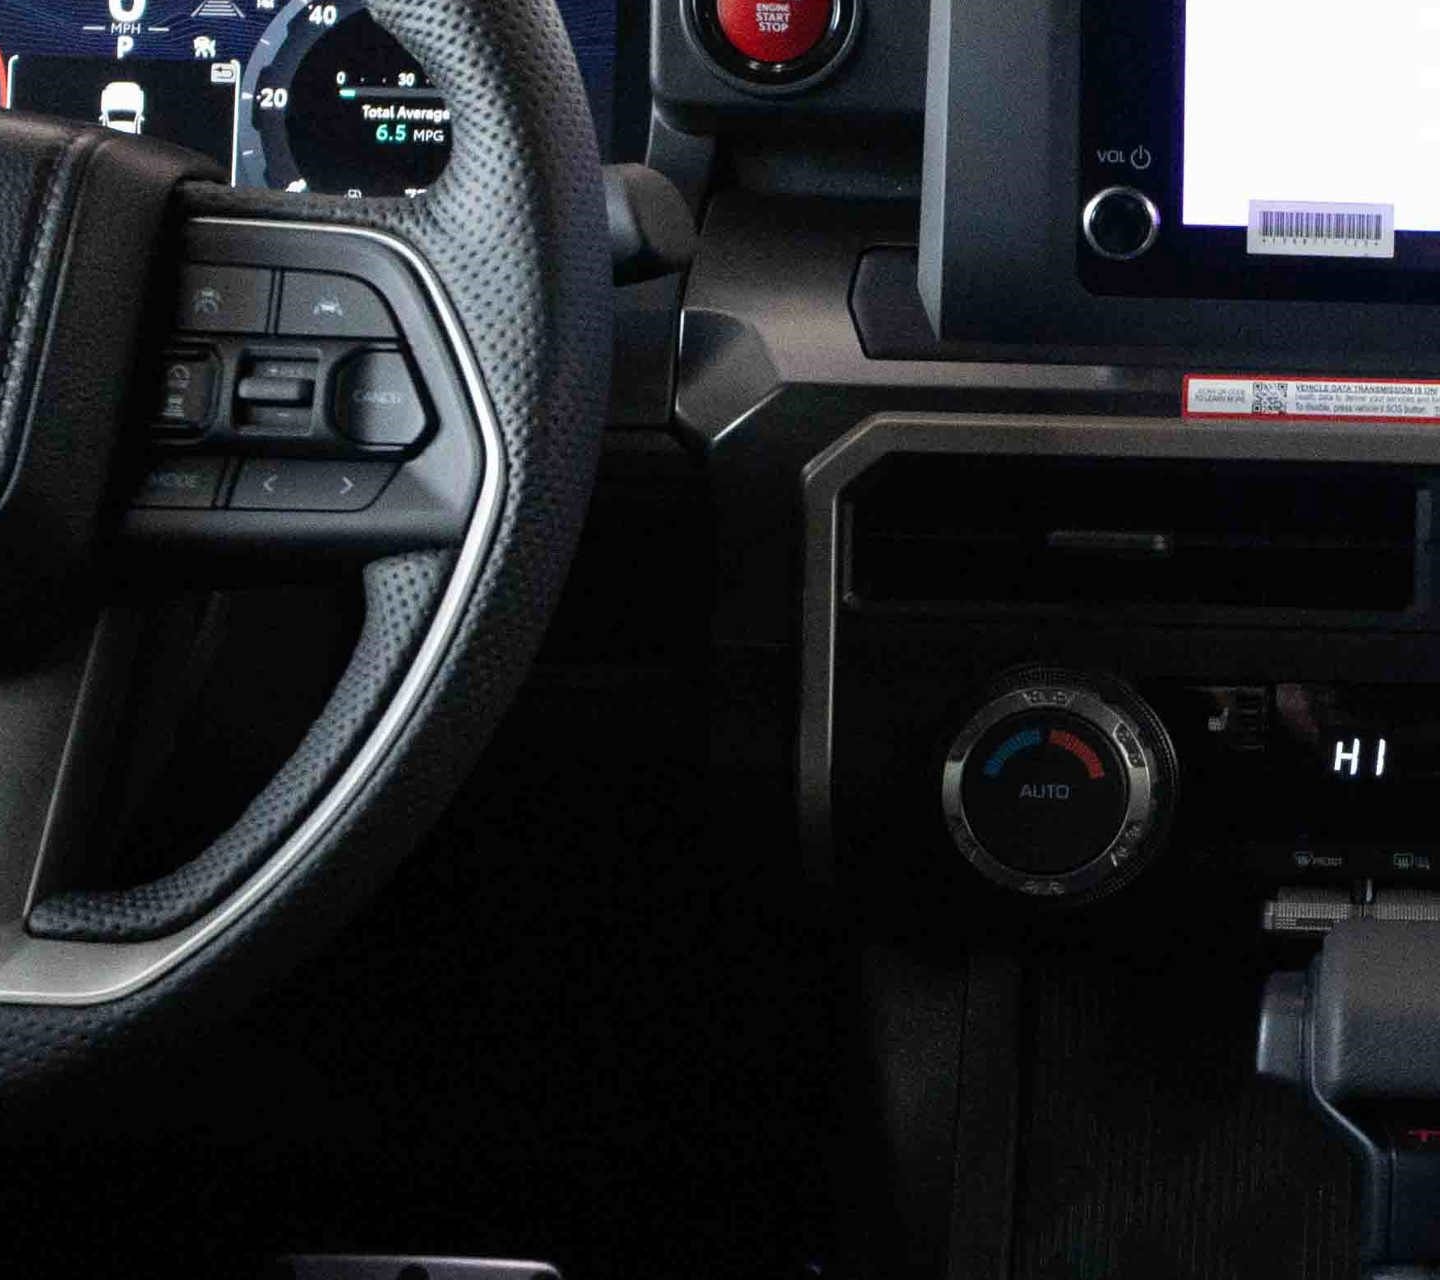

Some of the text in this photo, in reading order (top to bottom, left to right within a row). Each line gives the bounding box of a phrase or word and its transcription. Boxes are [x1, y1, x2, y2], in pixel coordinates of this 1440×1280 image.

[308, 4, 338, 27] 40
[755, 12, 791, 23] START
[110, 22, 141, 35] MPH
[759, 22, 790, 33] STOP
[116, 35, 134, 59] P
[398, 72, 416, 87] 30
[259, 87, 288, 109] 20
[362, 103, 450, 123] Total Average
[375, 124, 445, 142] 6.5 MPG
[1096, 149, 1126, 163] VOL
[1295, 384, 1329, 393] VEHICLE
[1331, 385, 1352, 394] DATA
[1333, 737, 1388, 777] HI
[1018, 783, 1080, 800] AUTO
